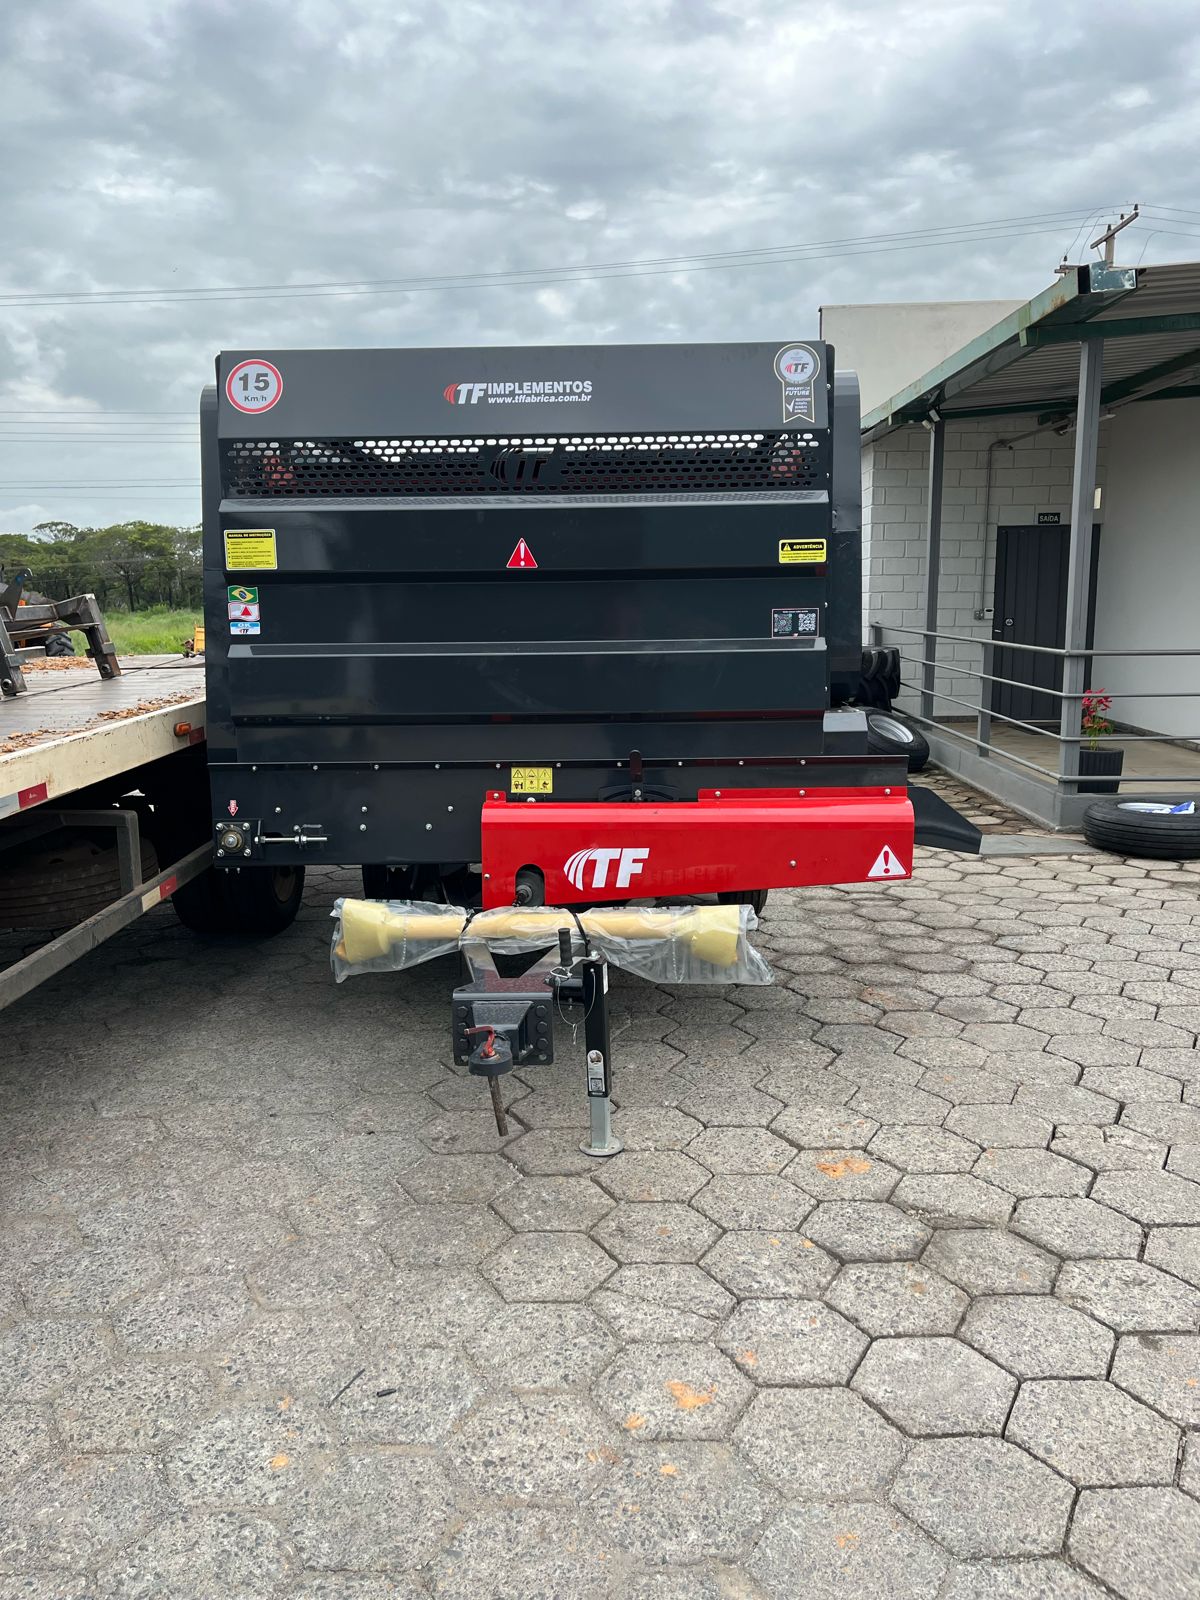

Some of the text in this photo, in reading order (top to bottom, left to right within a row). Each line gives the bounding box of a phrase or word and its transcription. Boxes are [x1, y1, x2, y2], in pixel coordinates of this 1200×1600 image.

[793, 362, 809, 373] TF
[238, 372, 270, 392] 15
[456, 380, 593, 405] TF IMPLEMENTOS
[487, 393, 592, 404] www.tffabrica.com.br
[588, 847, 650, 888] TF
